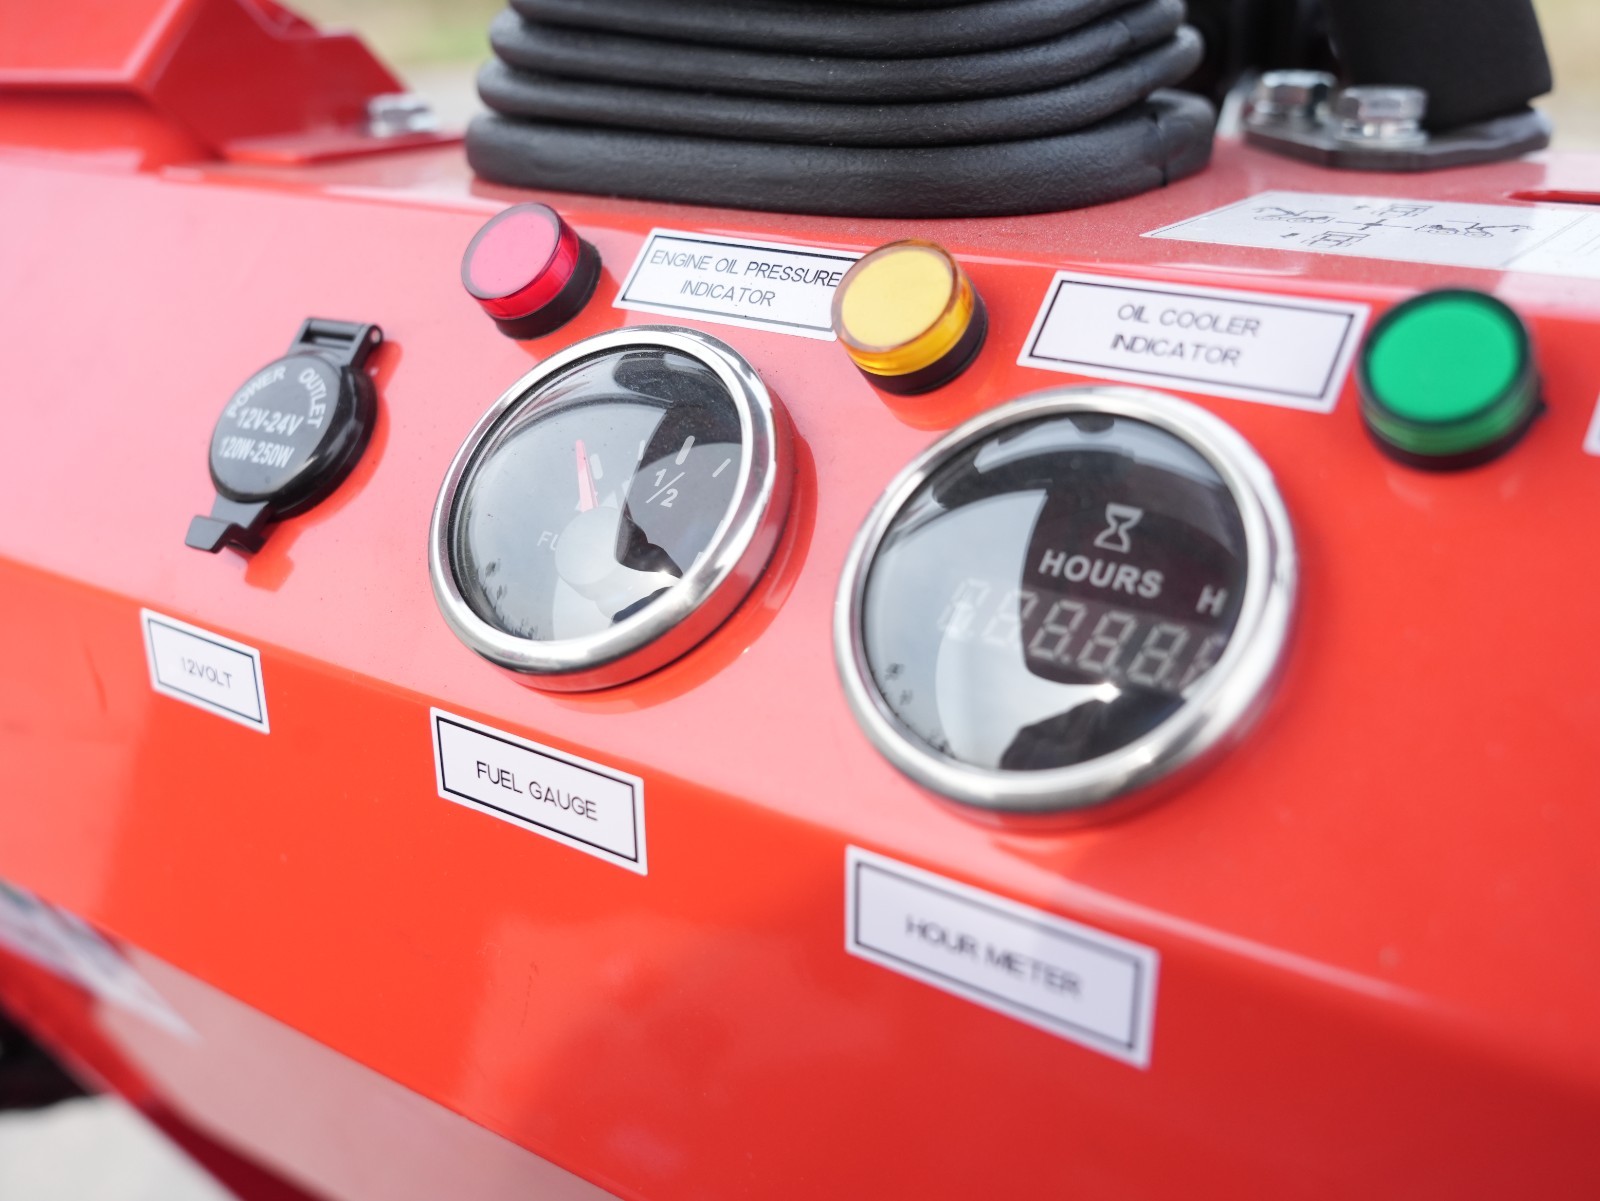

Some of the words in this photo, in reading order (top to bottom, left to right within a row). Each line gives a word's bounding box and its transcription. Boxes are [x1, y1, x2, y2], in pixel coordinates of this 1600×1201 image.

[650, 249, 712, 272] ENGINE
[714, 258, 739, 275] OIL
[744, 261, 843, 288] PRESSURE
[680, 279, 776, 307] INDICATOR
[1117, 303, 1150, 325] OIL
[1159, 309, 1260, 337] COOLER
[1111, 334, 1241, 366] INDICATOR
[227, 366, 286, 418] POWER
[299, 367, 327, 428] OUTLET
[238, 407, 304, 436] 12V-24V
[220, 436, 295, 468] 120W-250W
[1038, 549, 1164, 599] HOURS
[1196, 585, 1228, 617] H
[182, 657, 232, 688] 12VOLT
[476, 760, 523, 794] FUEL
[528, 780, 598, 822] GAUGE
[905, 914, 978, 962] HOUR
[985, 943, 1082, 998] METER
